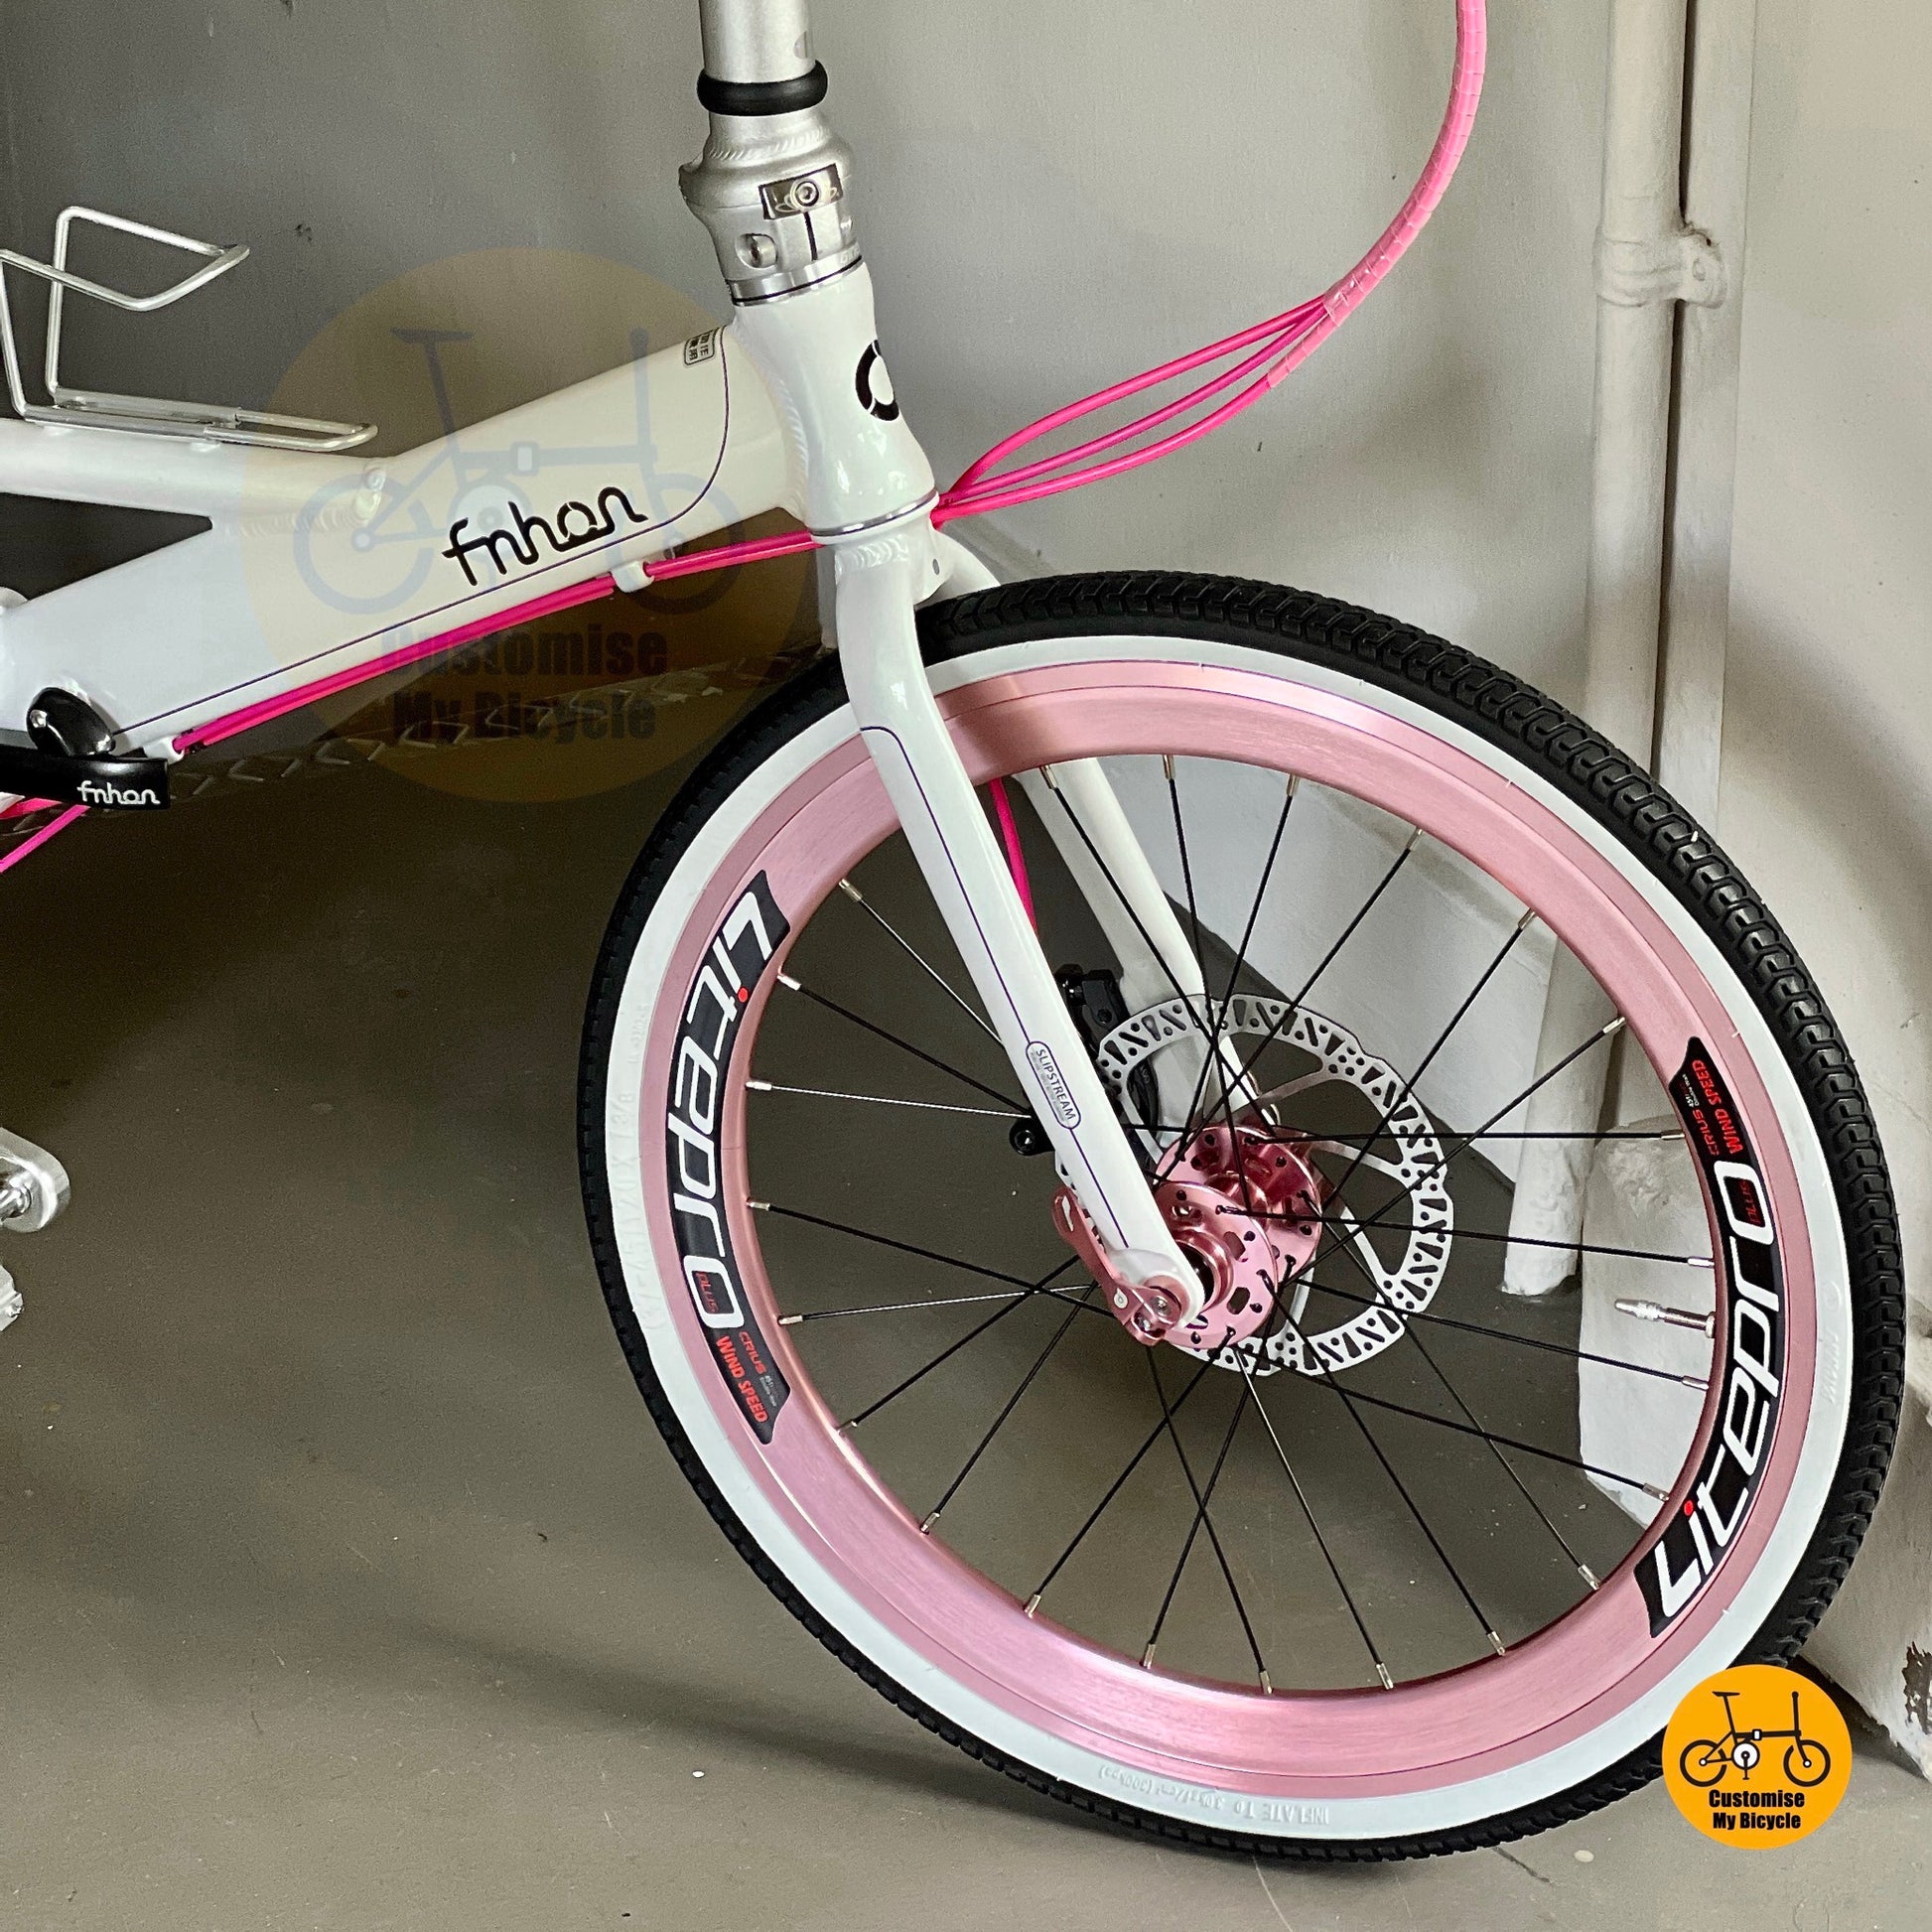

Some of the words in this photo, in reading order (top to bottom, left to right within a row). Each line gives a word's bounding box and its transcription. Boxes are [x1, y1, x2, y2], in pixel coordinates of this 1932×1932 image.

[443, 485, 648, 586] fnhon
[76, 779, 161, 805] fnhon
[668, 892, 772, 1328] Litepro
[1035, 1048, 1076, 1120] SLIPSTREAM
[1691, 1059, 1722, 1105] SPEED
[1714, 1108, 1743, 1155] WIND
[715, 1335, 746, 1379] WIND
[738, 1380, 768, 1424] SPEED
[739, 1331, 767, 1375] CRIUS
[1655, 1160, 1778, 1617] Litepro
